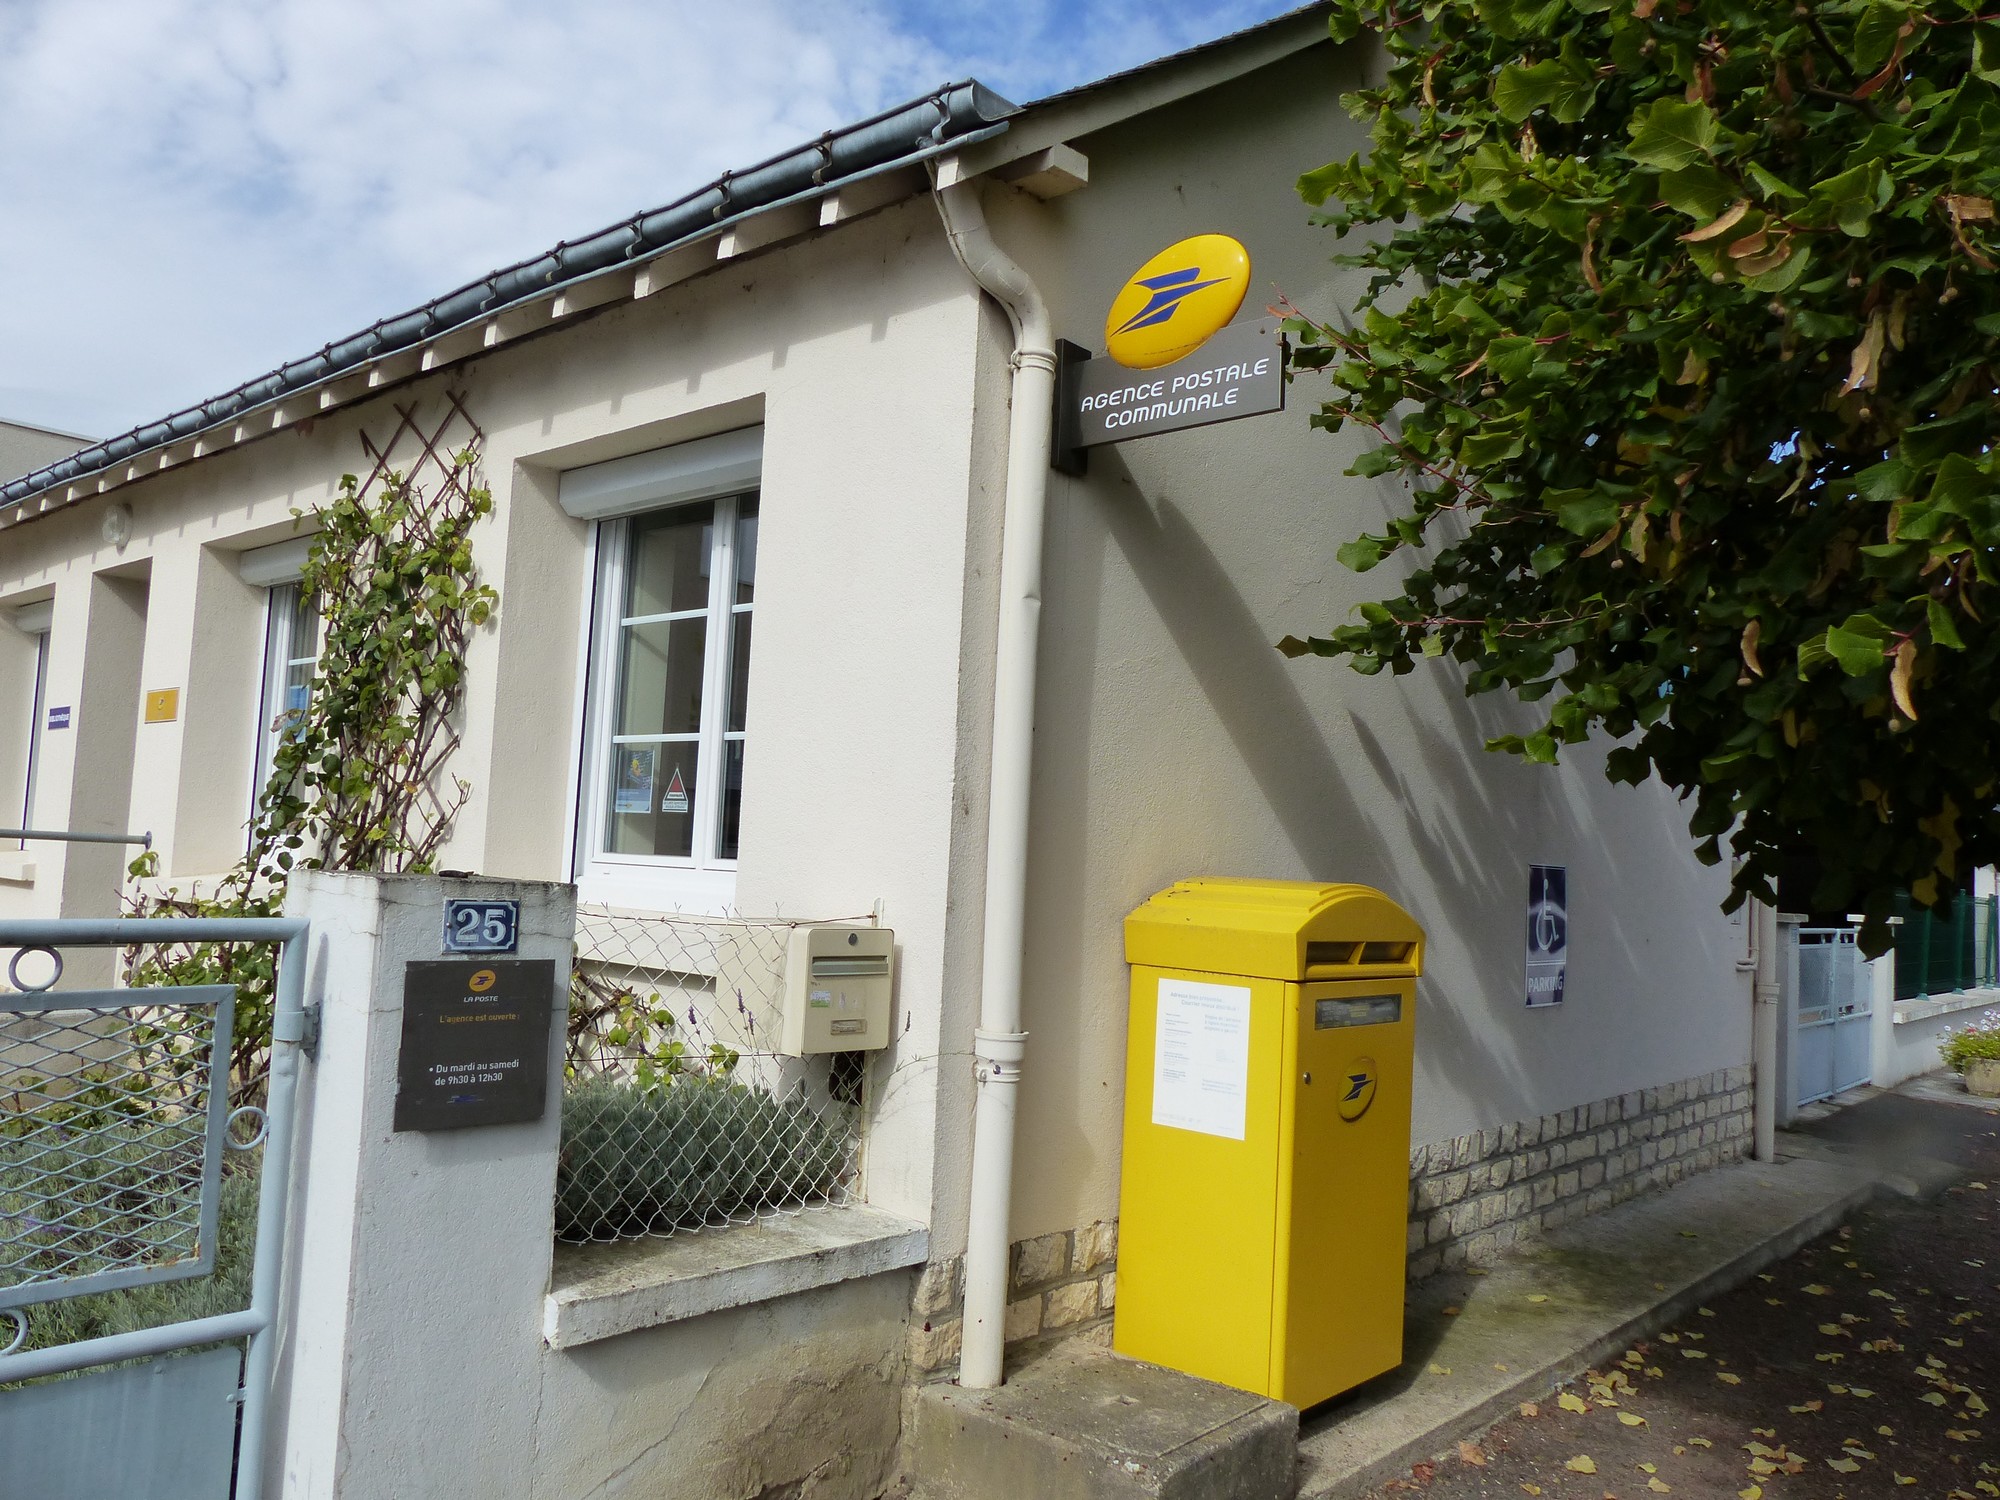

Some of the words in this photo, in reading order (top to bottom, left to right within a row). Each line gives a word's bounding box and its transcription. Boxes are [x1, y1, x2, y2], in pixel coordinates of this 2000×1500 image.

[1081, 380, 1165, 412] AGENCE
[1171, 358, 1270, 394] POSTALE
[1105, 388, 1240, 429] COMMUNALE
[455, 908, 507, 943] 25
[1528, 975, 1563, 993] PARKING
[474, 995, 499, 1003] POSTE
[439, 1014, 474, 1024] L'agence
[475, 1014, 487, 1022] est
[436, 1064, 448, 1073] Du
[450, 1062, 476, 1073] mardi
[477, 1063, 488, 1071] au
[489, 1059, 520, 1069] samedi
[435, 1077, 446, 1086] de
[448, 1074, 468, 1085] 9h30
[470, 1074, 476, 1083] à
[478, 1072, 503, 1083] 12h30
